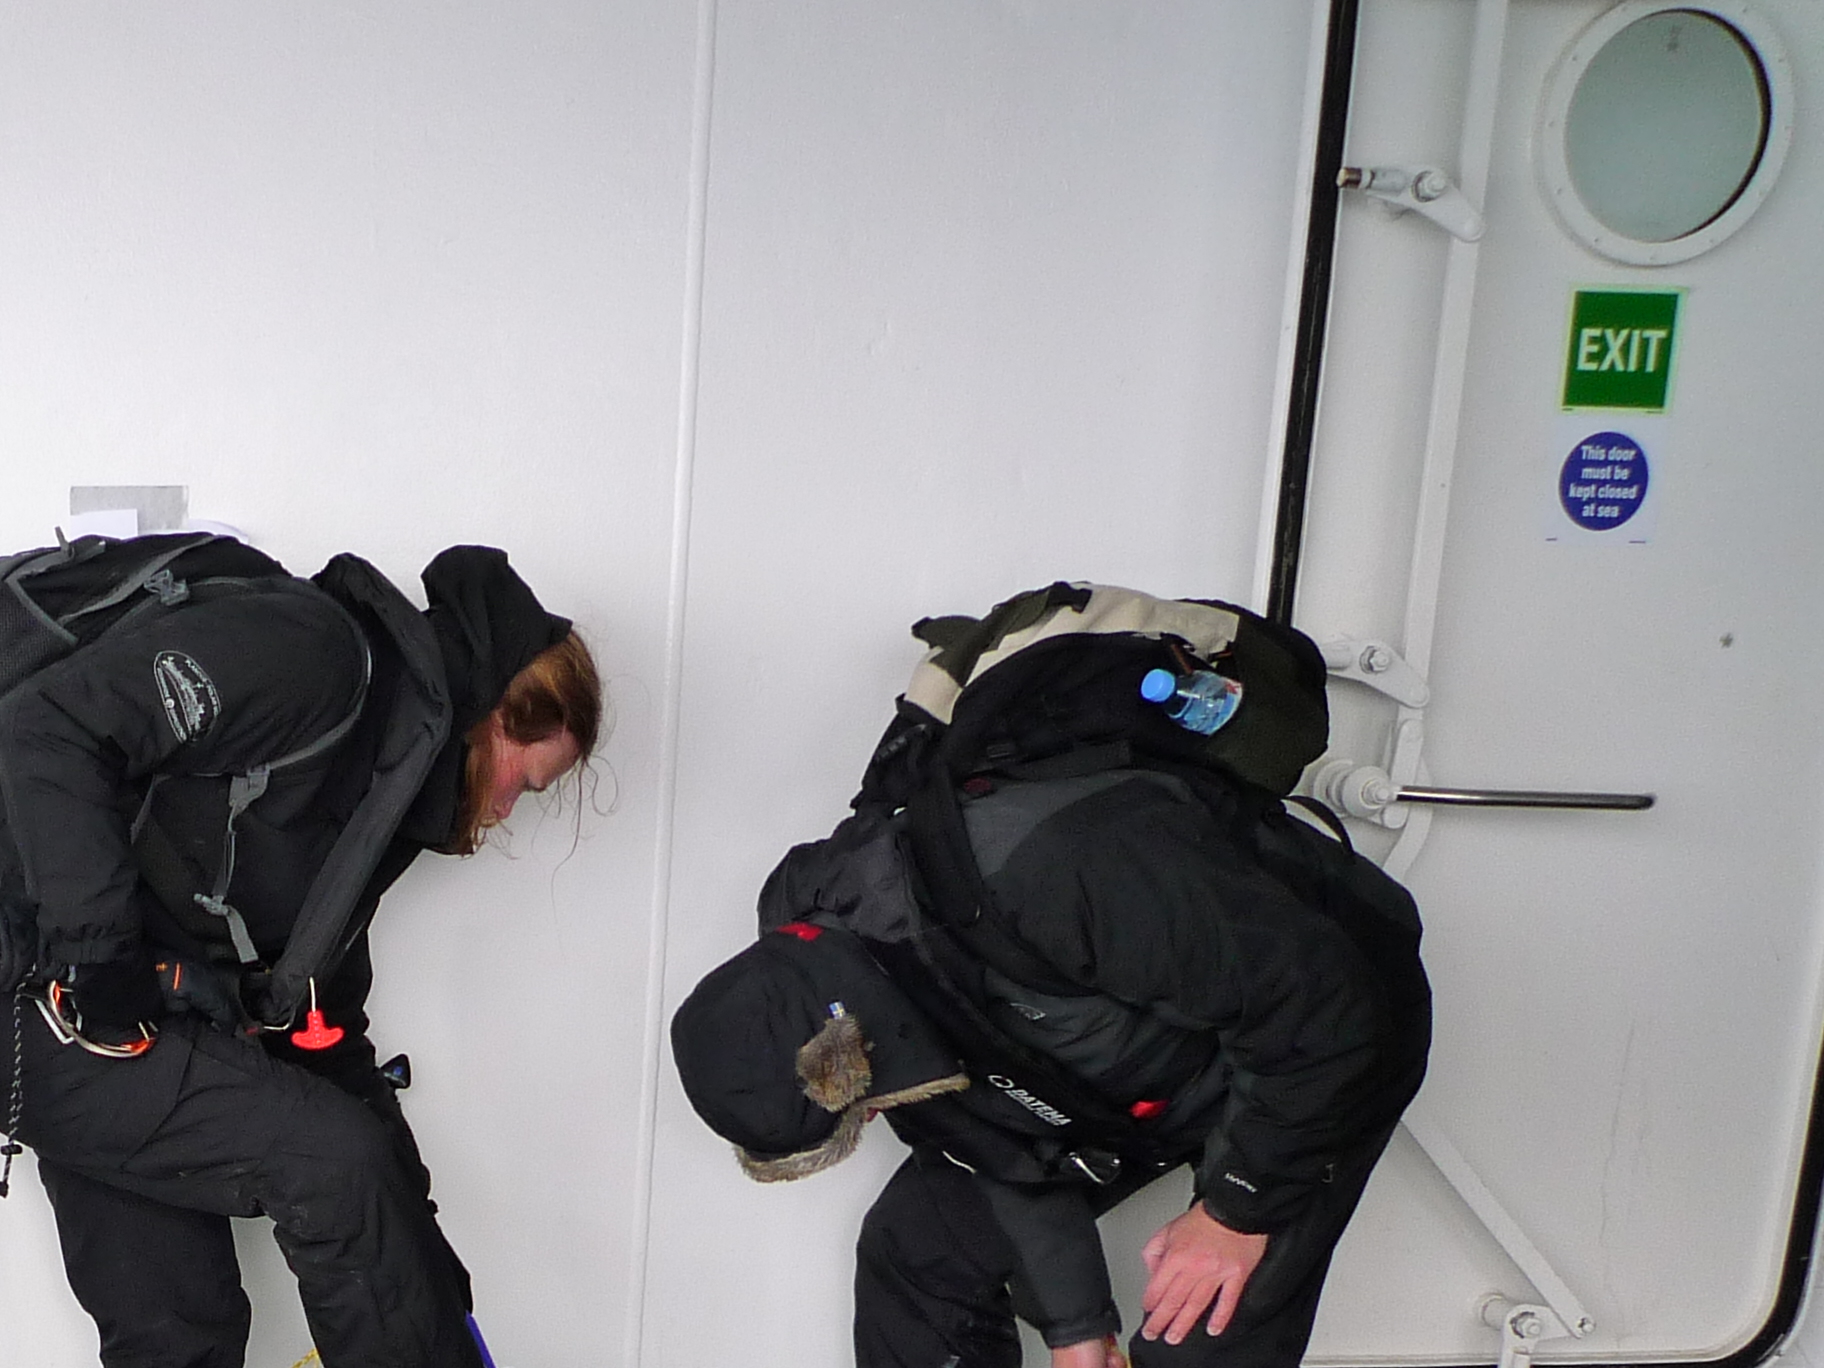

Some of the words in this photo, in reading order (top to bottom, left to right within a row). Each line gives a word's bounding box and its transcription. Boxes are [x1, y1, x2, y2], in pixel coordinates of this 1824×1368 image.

[1577, 327, 1669, 372] EXIT
[1581, 445, 1606, 460] This
[1608, 446, 1636, 461] door
[1581, 465, 1611, 479] must
[1614, 465, 1629, 480] be
[1569, 483, 1595, 501] kept
[1598, 484, 1638, 499] closed
[1582, 503, 1595, 517] at
[1597, 505, 1619, 517] sea
